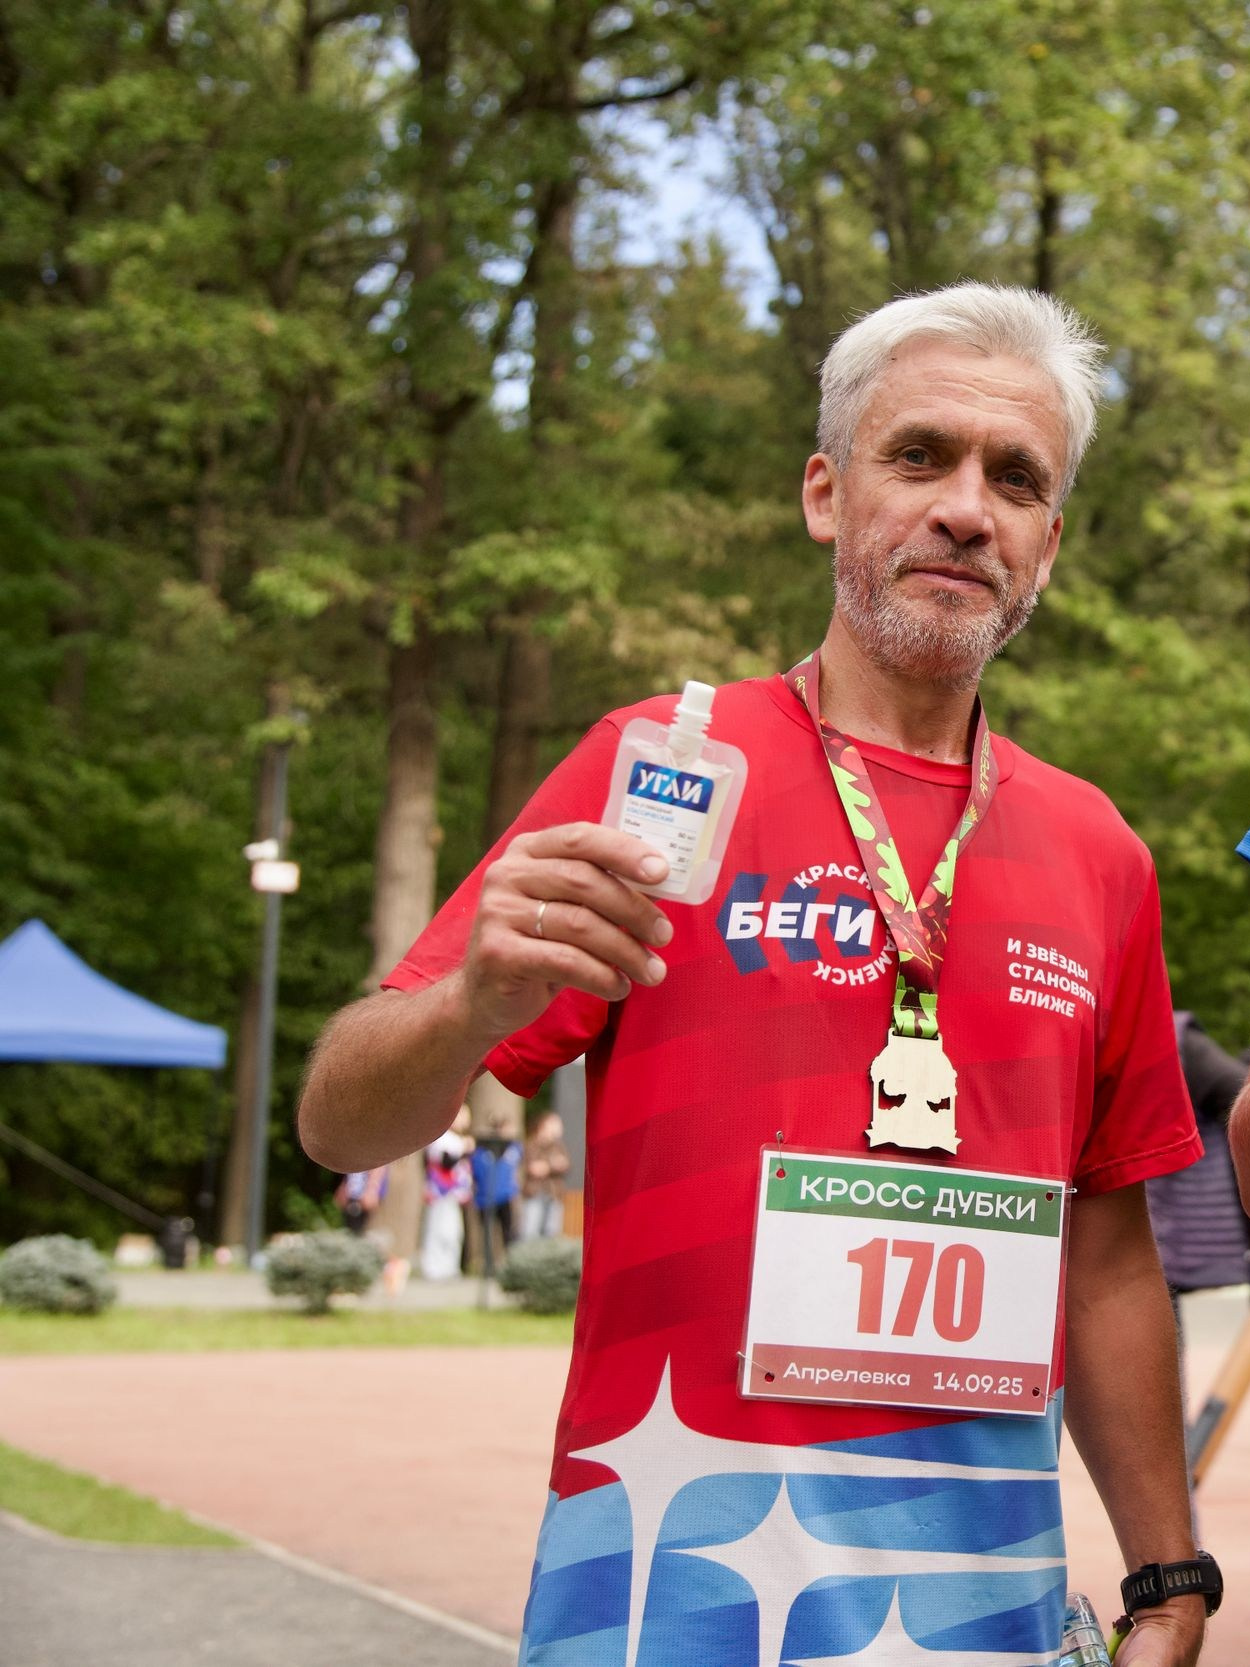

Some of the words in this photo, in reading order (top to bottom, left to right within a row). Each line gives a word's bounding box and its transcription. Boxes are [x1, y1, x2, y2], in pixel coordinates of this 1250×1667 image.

[638, 768, 703, 804] УГЛИ
[726, 902, 876, 946] БЕГИ
[1007, 938, 1021, 954] И
[1026, 943, 1088, 981] ЗВЁЗДЫ
[1009, 986, 1076, 1018] БЛИЖЕ
[800, 1175, 926, 1209] КРОСС
[932, 1187, 1036, 1222] ДУБКИ
[847, 1237, 985, 1342] 170
[783, 1362, 911, 1387] Апрелевка
[933, 1372, 1023, 1395] 14.09.25
